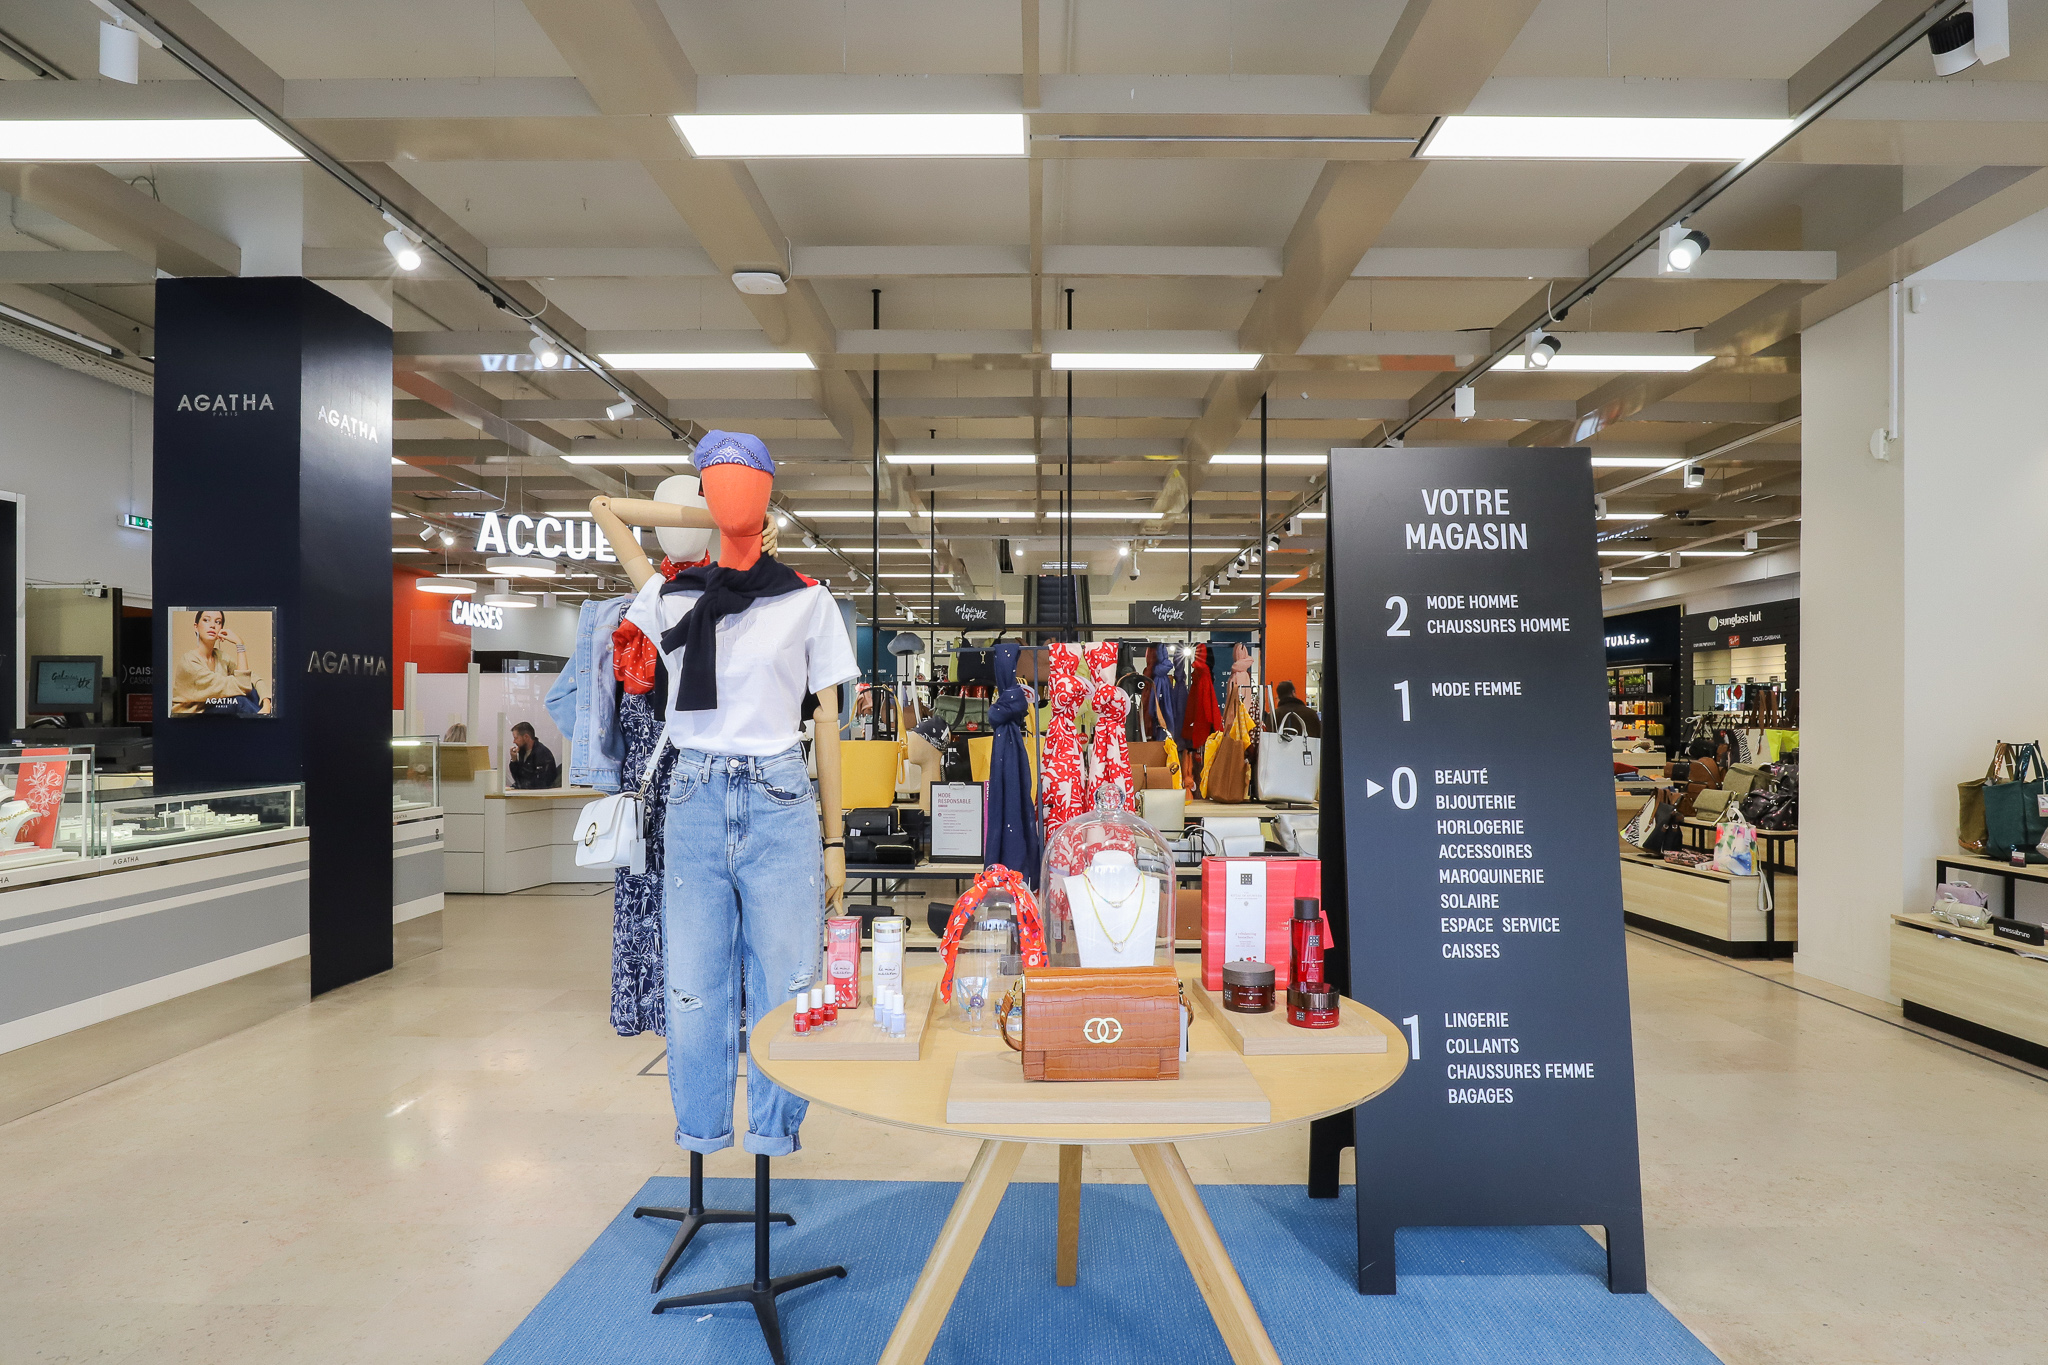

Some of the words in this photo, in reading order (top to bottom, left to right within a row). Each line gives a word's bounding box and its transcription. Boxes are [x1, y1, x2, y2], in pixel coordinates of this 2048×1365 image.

[176, 393, 275, 412] AGATHA
[317, 405, 379, 444] AGATHA
[1421, 488, 1510, 516] VOTRE
[1405, 522, 1528, 550] MAGASIN
[1426, 595, 1466, 610] MODE
[1469, 594, 1519, 609] HOMME
[452, 600, 503, 630] CAISSES
[1384, 595, 1411, 637] 2
[1718, 614, 1749, 628] sunglass
[1749, 611, 1761, 623] hut
[1427, 619, 1517, 634] CHAUSSURES
[1520, 617, 1571, 632] HOMME
[128, 666, 153, 676] CAIS
[307, 650, 388, 676] AGATHA
[1431, 682, 1471, 697] MODE
[1474, 681, 1522, 696] FEMME
[205, 698, 239, 706] AGATHA
[1393, 679, 1411, 722] 1
[1435, 768, 1489, 785] BEAUTÉ
[1391, 766, 1418, 809] 0
[1436, 795, 1517, 810] BIJOUTERIE
[1437, 820, 1525, 835] HORLOGERIE
[1439, 844, 1533, 859] ACCESSOIRES
[112, 855, 140, 866] AGATHA
[1439, 868, 1545, 884] MAROQUINERIE
[1440, 893, 1500, 909] SOLAIRE
[1440, 917, 1494, 933] ESPACE
[1502, 917, 1561, 933] SERVICE
[1442, 943, 1501, 959] CAISSES
[1444, 1012, 1510, 1028] LINGERIE
[1403, 1014, 1421, 1060] 1
[1446, 1038, 1520, 1054] COLLANTS
[1447, 1064, 1541, 1080] CHAUSSURES
[1545, 1063, 1595, 1079] FEMME
[1448, 1088, 1514, 1104] BAGAGES
